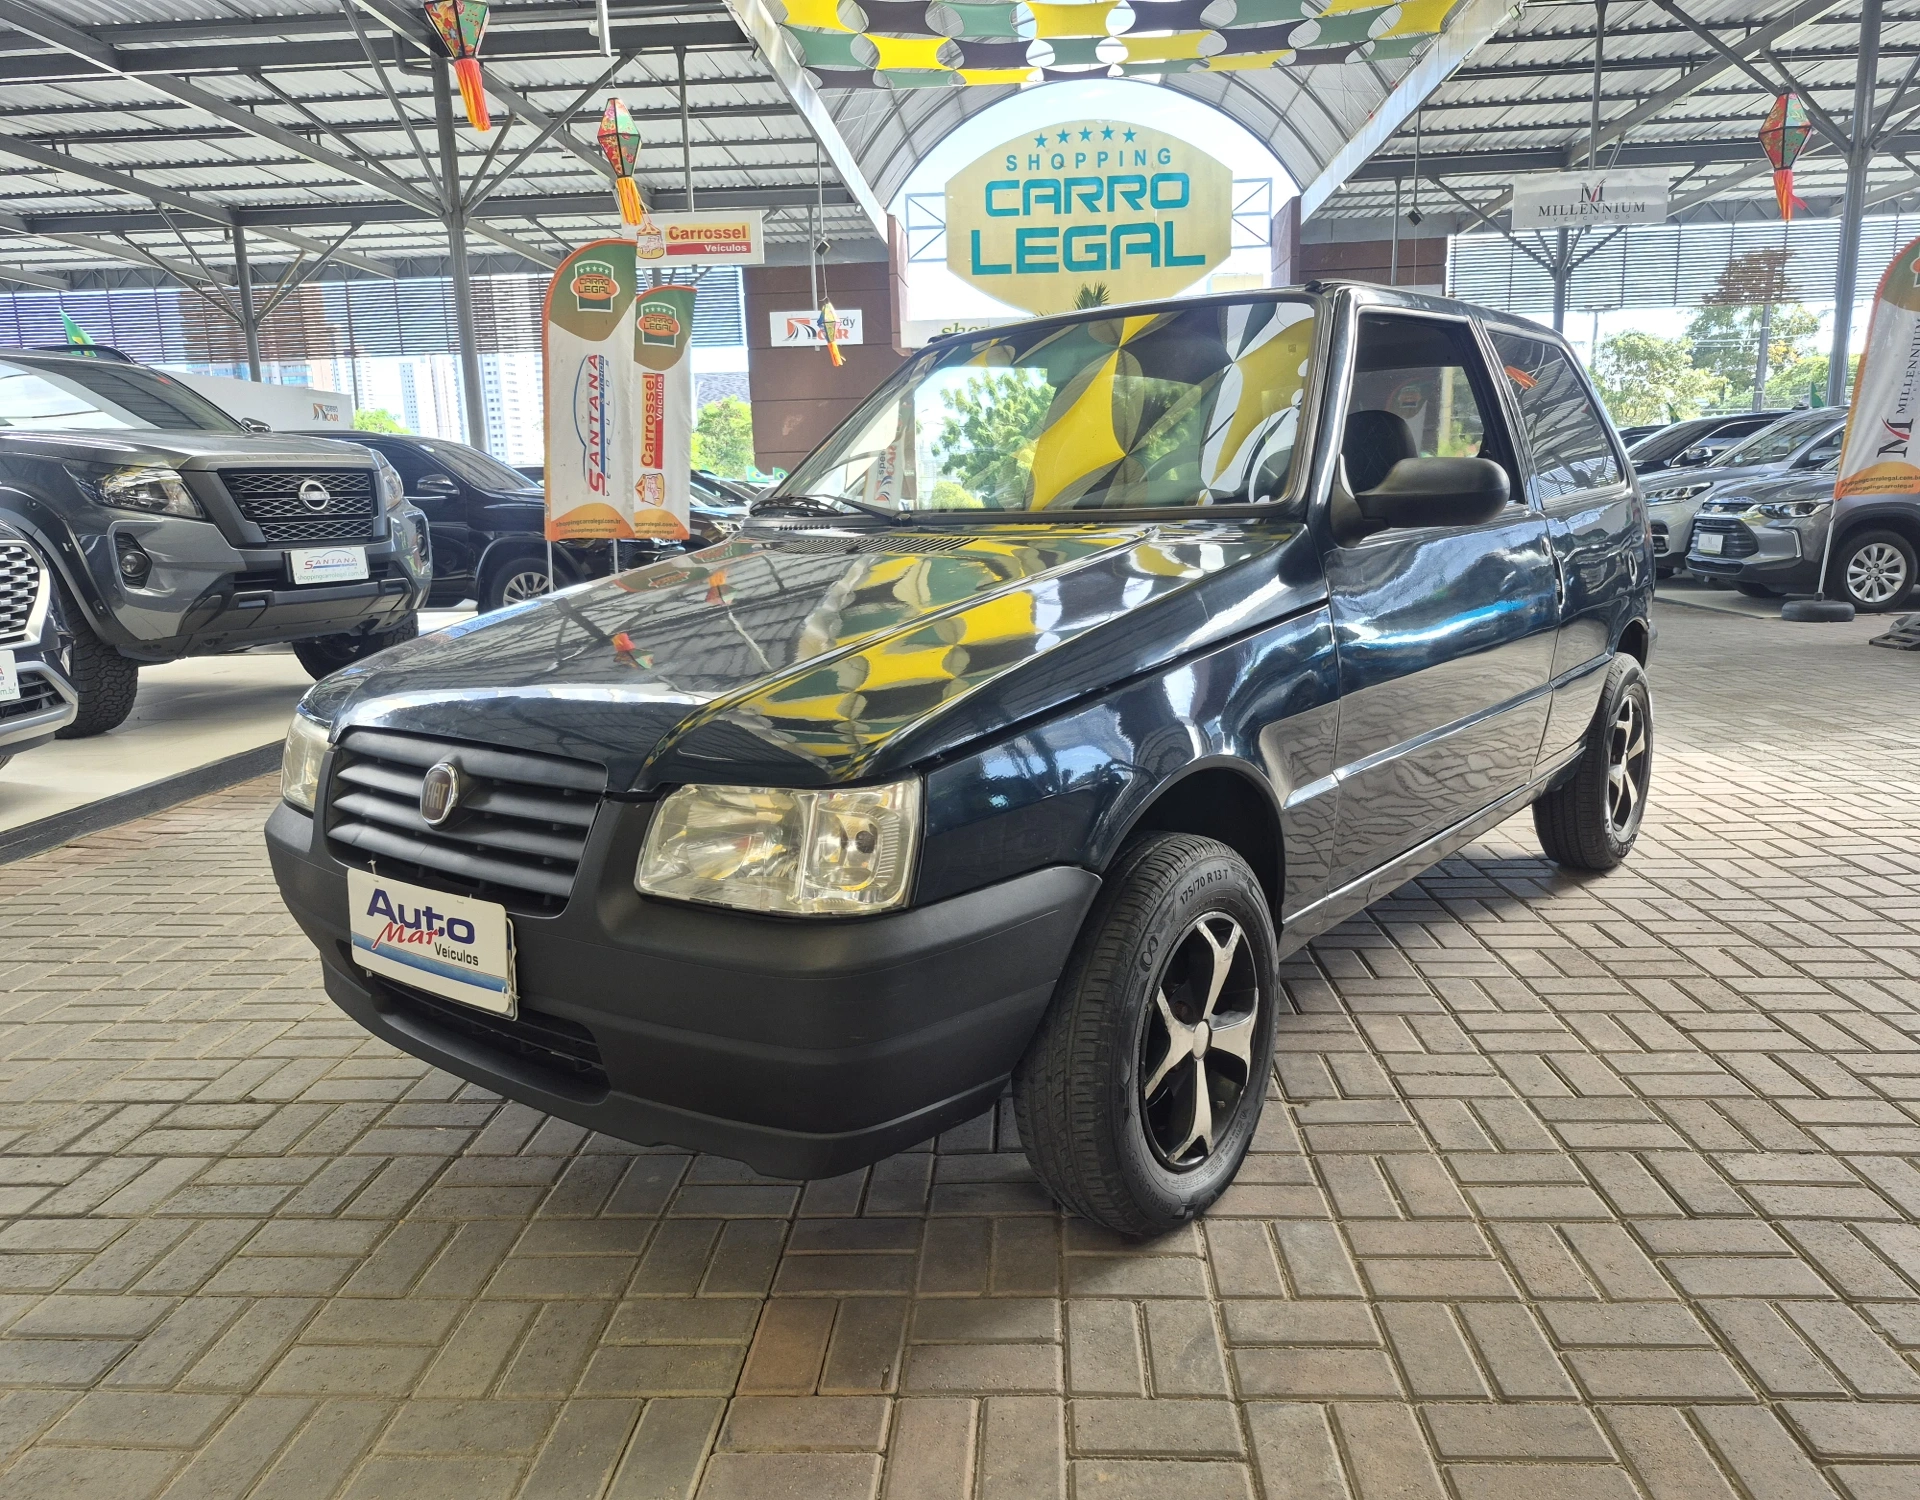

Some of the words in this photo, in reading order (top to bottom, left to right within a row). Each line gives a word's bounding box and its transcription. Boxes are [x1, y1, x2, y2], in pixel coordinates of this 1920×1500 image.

[1005, 148, 1171, 172] SHOPPING
[985, 172, 1190, 218] CARRO
[1538, 202, 1646, 217] MILLENNIUM
[668, 225, 747, 241] Carrossel
[971, 220, 1206, 276] LEGAL
[578, 285, 612, 295] LEGAL
[579, 277, 611, 286] CARRO
[643, 322, 675, 333] LEGAL
[644, 316, 674, 325] CARRO
[588, 354, 606, 497] SANTANA
[641, 373, 656, 467] Carrossel
[303, 557, 357, 570] SANTANA
[425, 781, 448, 809] FIAT
[1180, 876, 1206, 905] 175/70
[366, 888, 476, 945] Auto
[371, 920, 439, 950] Mar
[434, 942, 479, 966] Veículos
